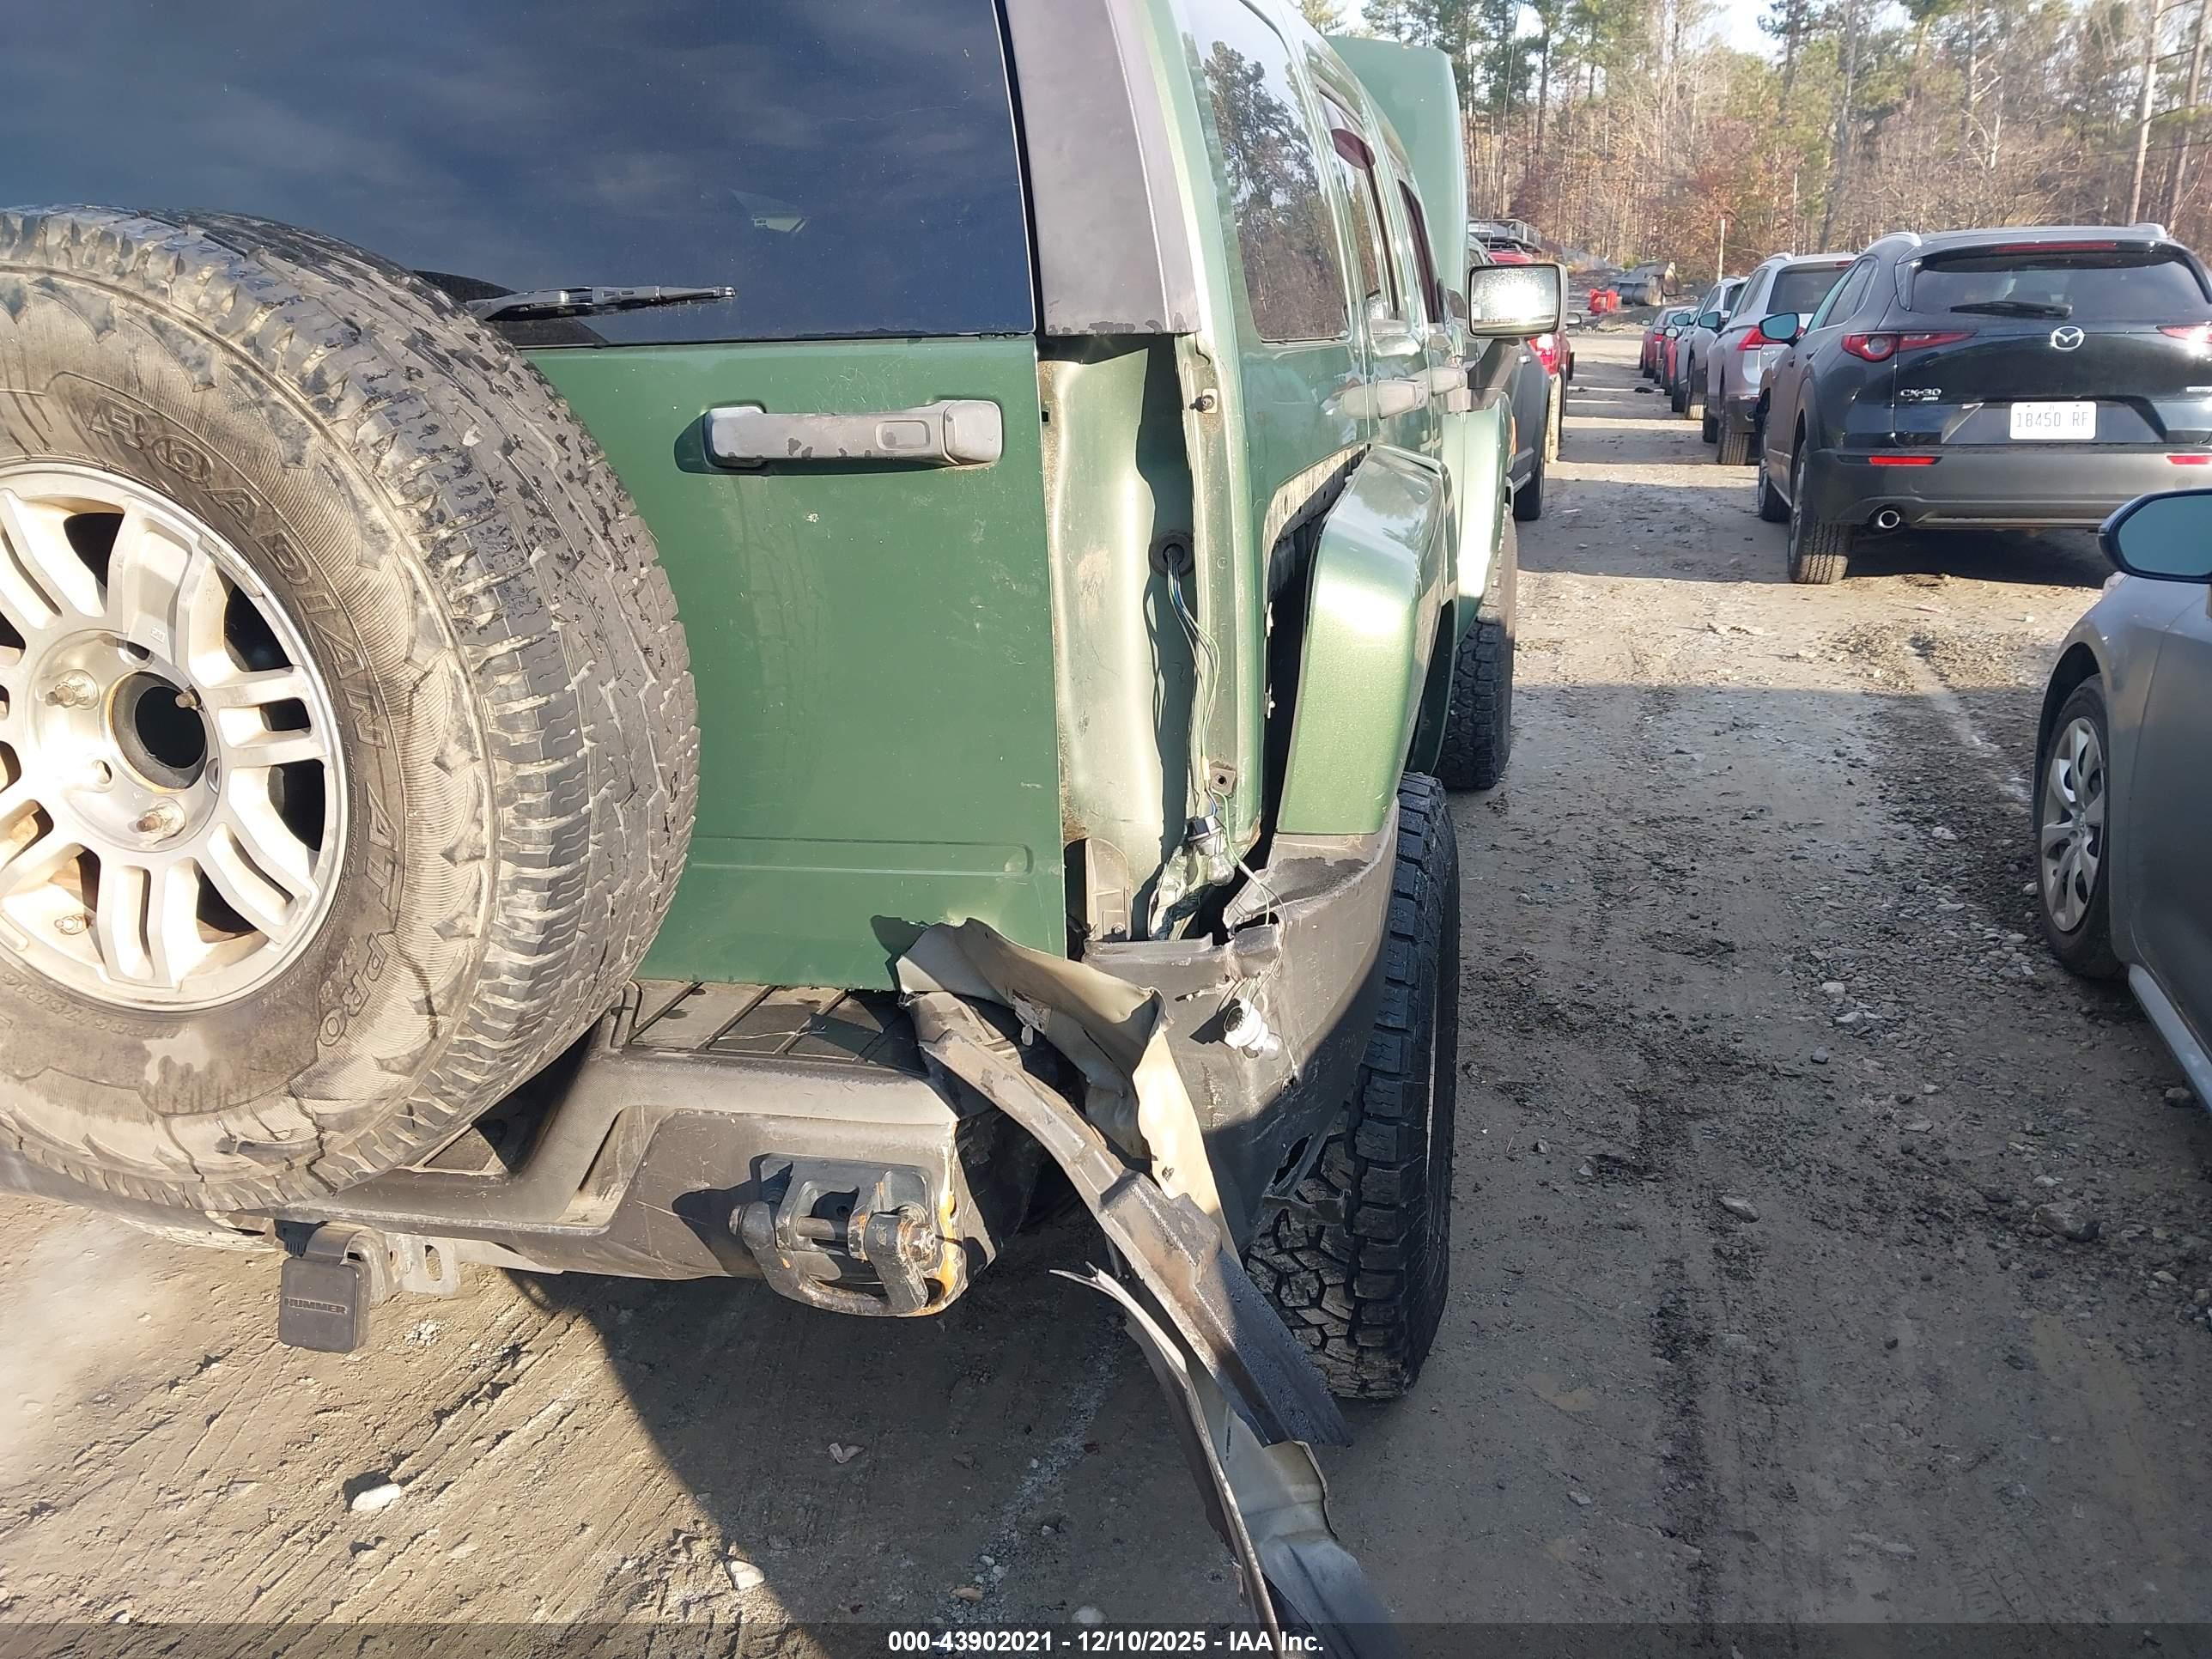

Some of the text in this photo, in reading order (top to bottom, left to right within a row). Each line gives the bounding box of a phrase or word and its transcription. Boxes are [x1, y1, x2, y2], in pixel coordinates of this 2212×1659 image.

[2072, 411, 2088, 427] RF
[88, 395, 389, 750] ROADIAN
[319, 933, 386, 1047] PRO
[284, 1297, 348, 1315] HUMMER
